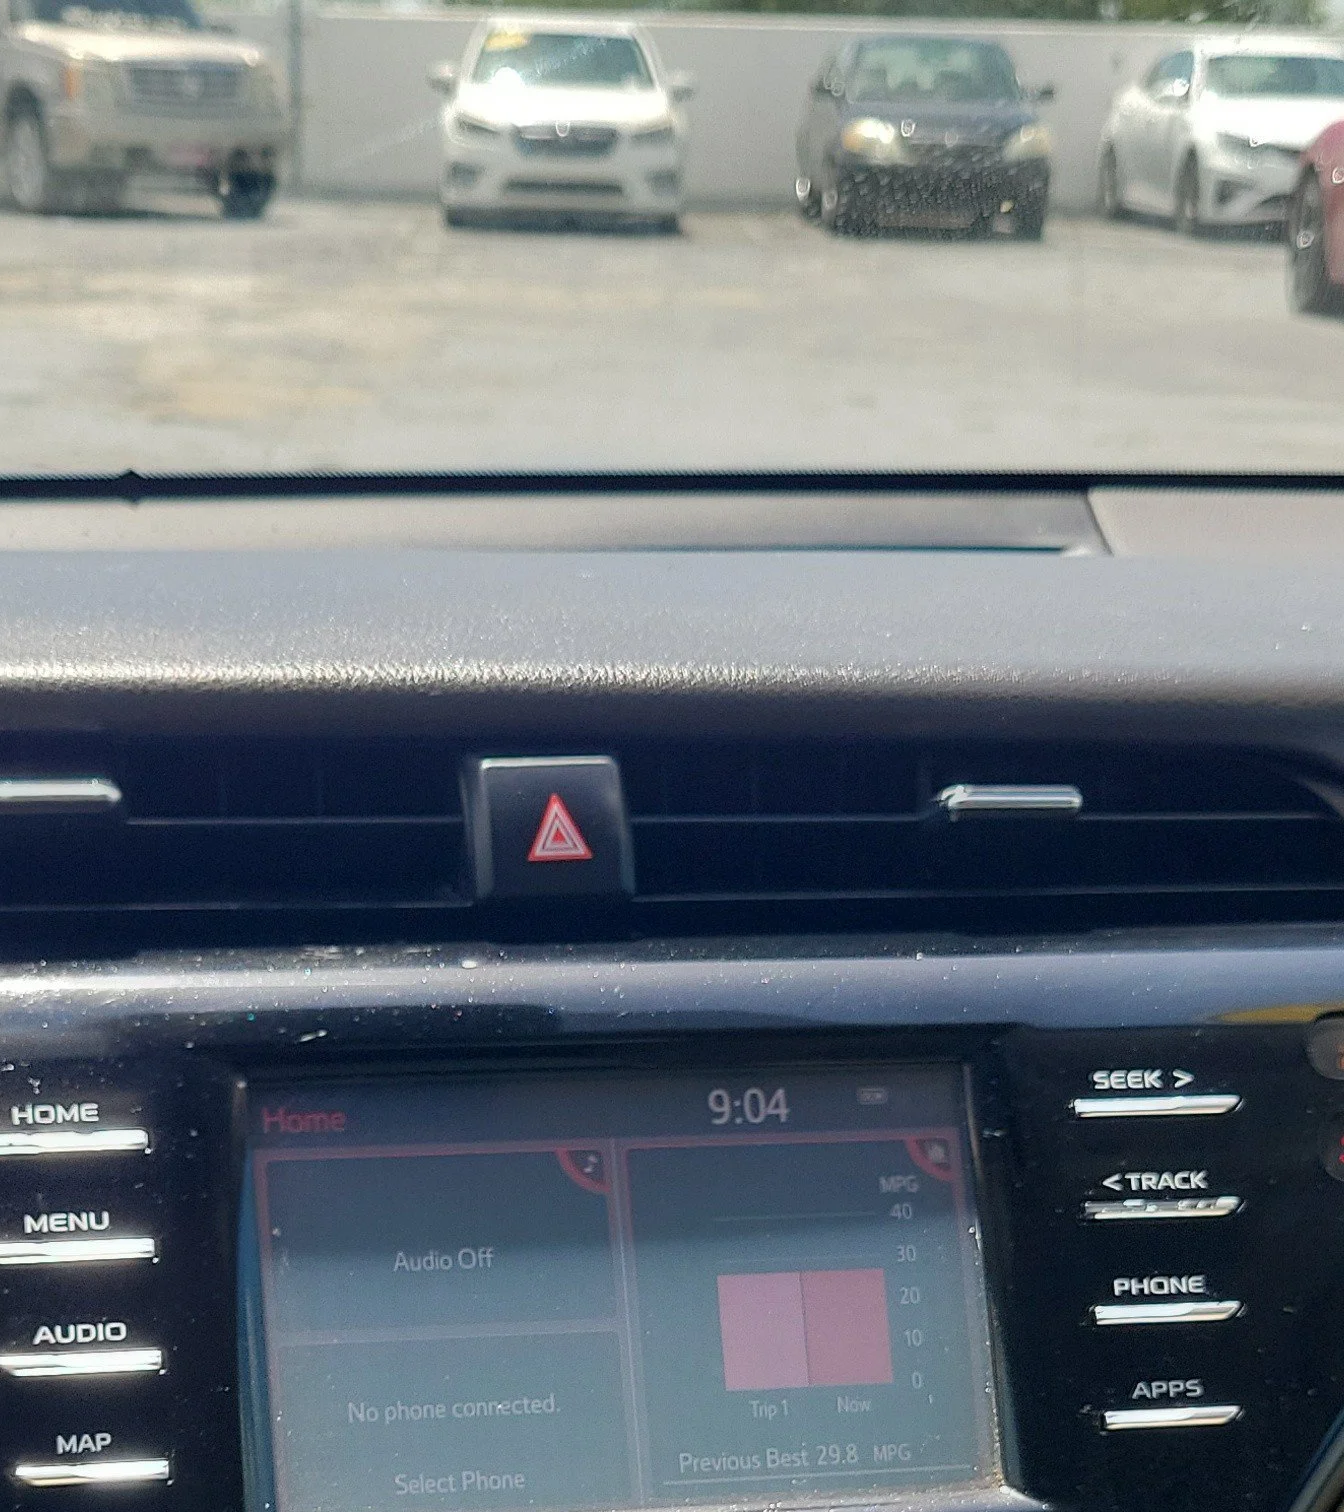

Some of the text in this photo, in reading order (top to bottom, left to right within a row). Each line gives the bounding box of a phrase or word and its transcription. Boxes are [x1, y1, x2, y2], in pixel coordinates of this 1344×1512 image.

[1092, 1069, 1163, 1090] SEEK
[11, 1102, 100, 1126] HOME
[708, 1087, 790, 1125] 9:04
[261, 1106, 347, 1133] Home
[878, 1175, 920, 1194] MPG
[1124, 1170, 1208, 1191] TRACK
[889, 1202, 913, 1220] 40
[23, 1210, 111, 1235] MENU
[394, 1247, 494, 1273] Audio Off
[896, 1245, 917, 1263] 30
[900, 1286, 921, 1305] 20
[1113, 1274, 1206, 1296] PHONE
[32, 1321, 127, 1346] AUDIO
[905, 1329, 922, 1348] 10
[912, 1371, 923, 1389] 0
[1131, 1378, 1205, 1400] APPS
[347, 1392, 561, 1425] No phone connected.
[749, 1399, 789, 1421] Trip 1
[836, 1395, 872, 1415] Now
[56, 1432, 112, 1455] MAP
[679, 1443, 912, 1474] Previous Best 29.8 MPG
[394, 1469, 526, 1495] Select Phone
